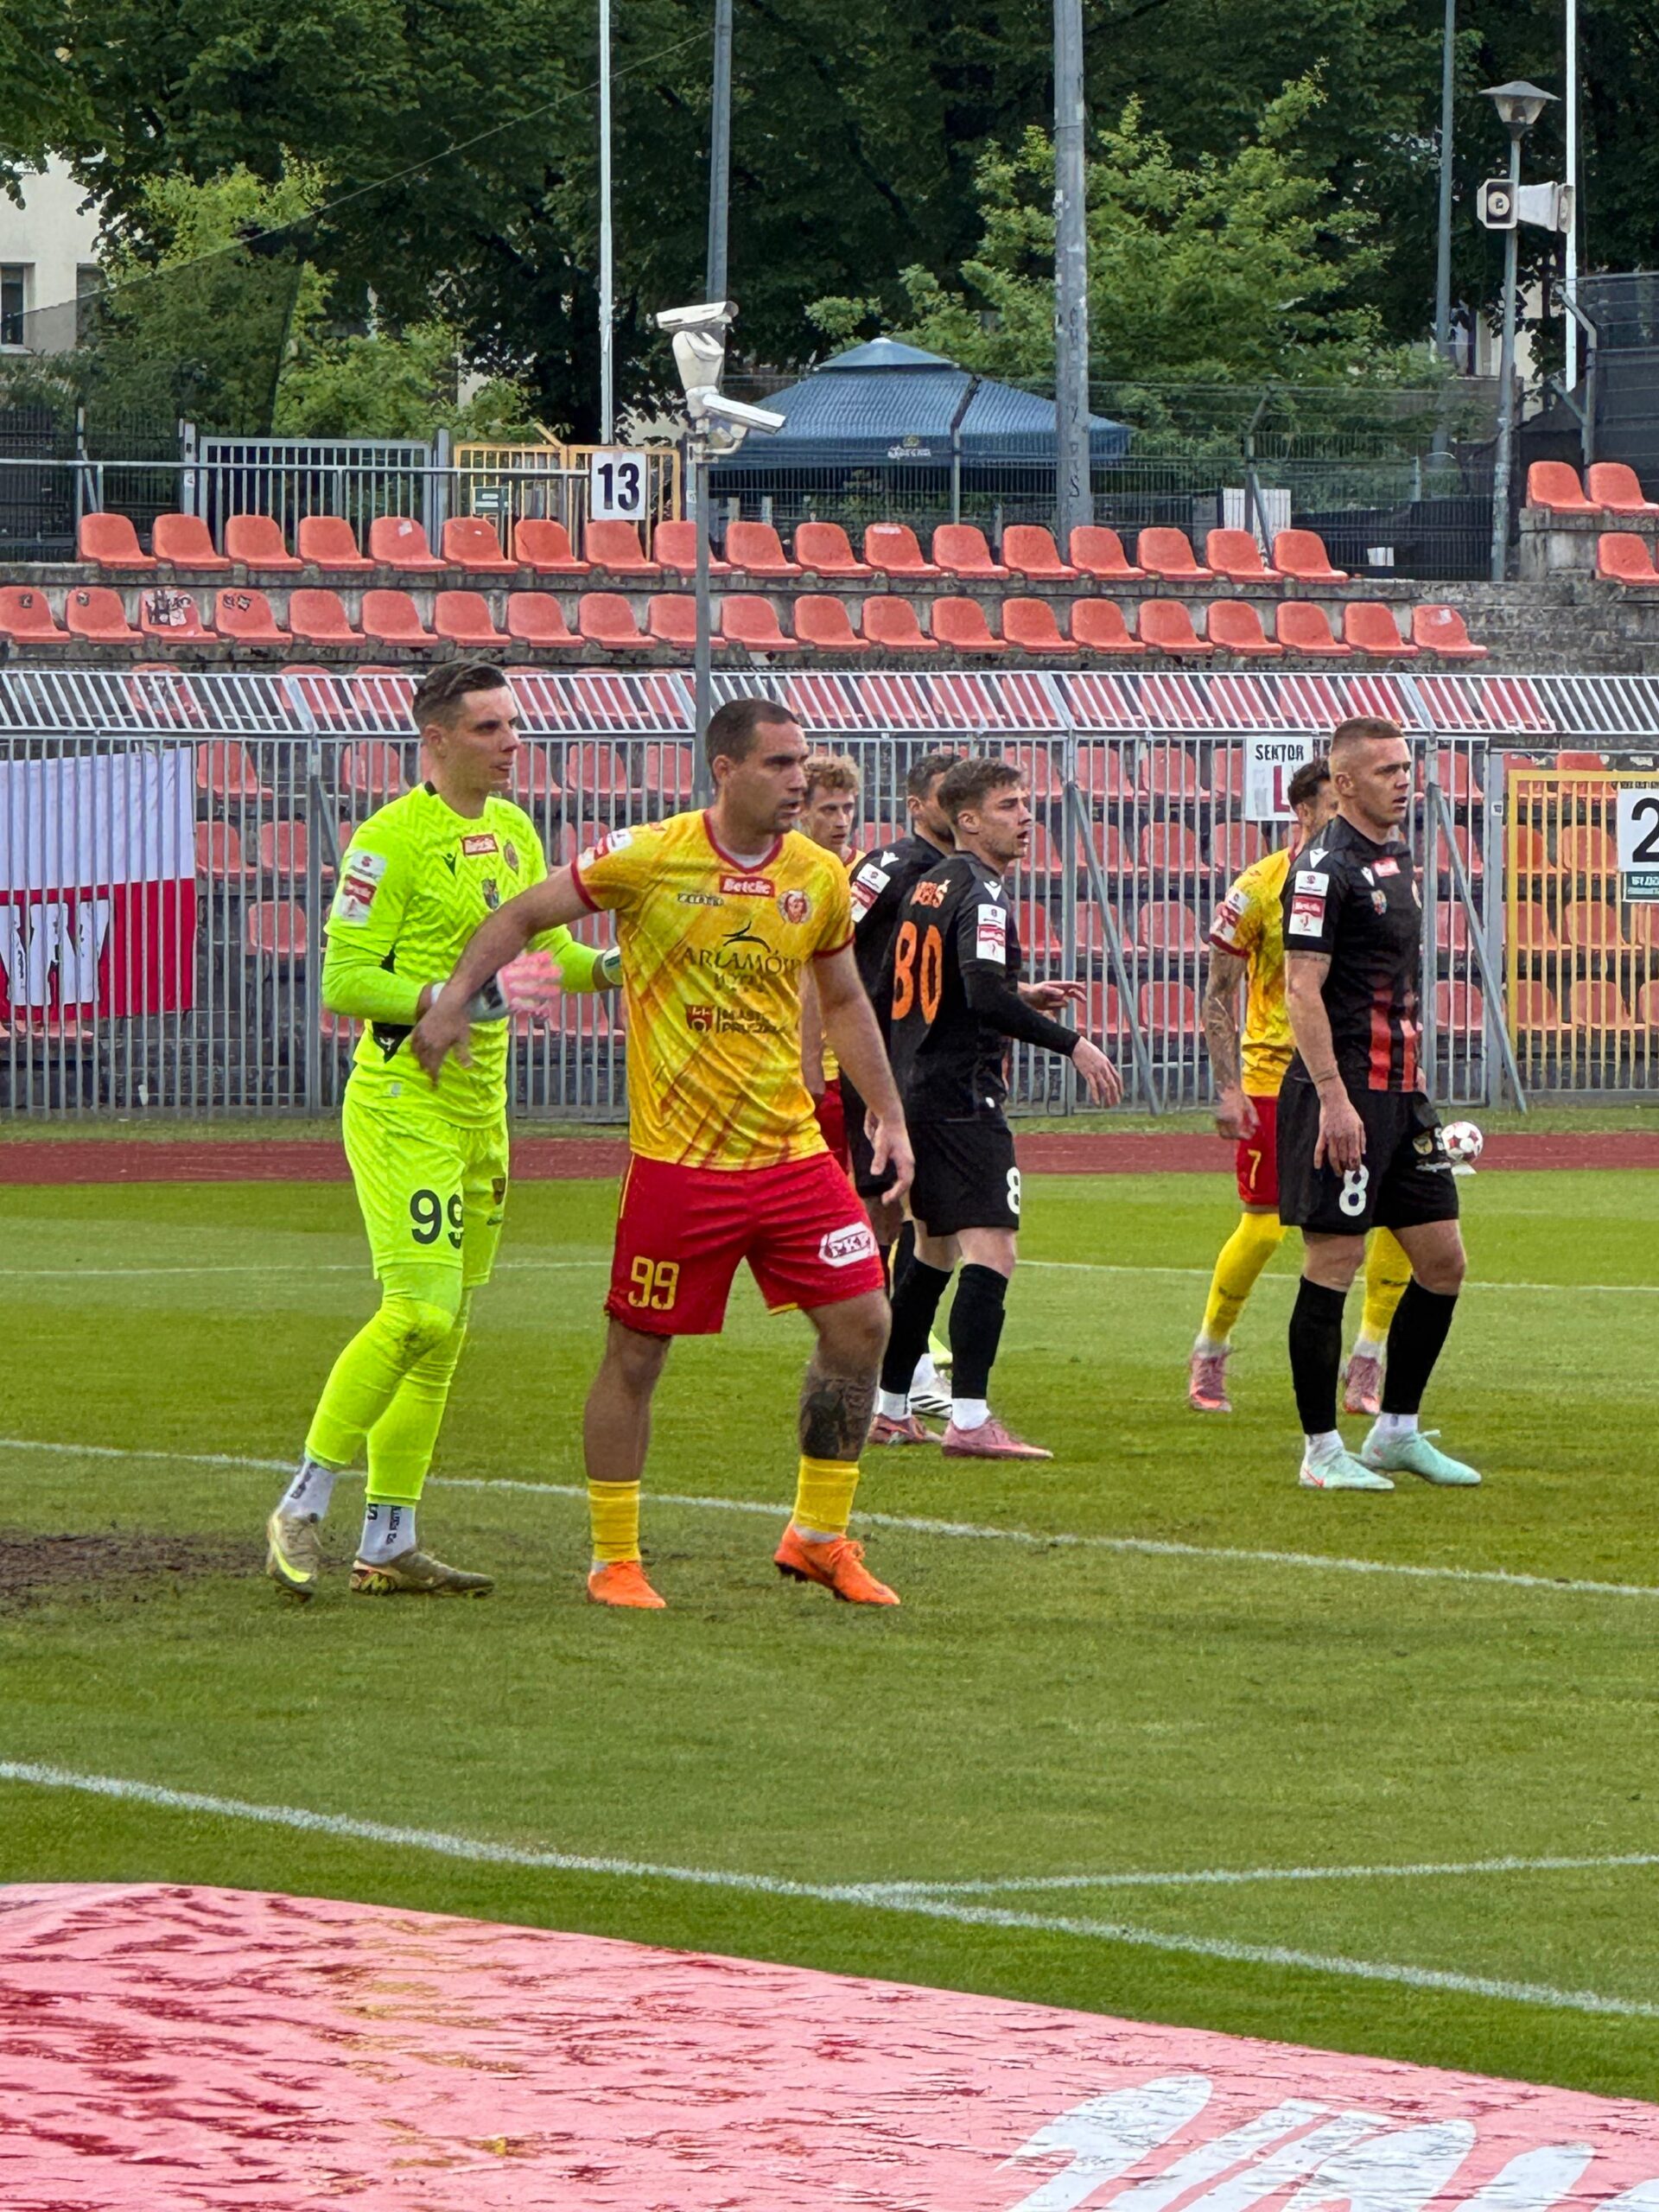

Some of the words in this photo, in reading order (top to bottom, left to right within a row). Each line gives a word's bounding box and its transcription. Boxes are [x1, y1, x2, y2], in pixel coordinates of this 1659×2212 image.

[598, 462, 639, 512] 13
[1255, 744, 1304, 762] SEKTOR
[891, 920, 943, 1026] 80
[1006, 1166, 1021, 1215] 8
[1247, 1148, 1262, 1190] 7
[1339, 1164, 1370, 1217] 8
[410, 1189, 464, 1249] 99
[628, 1255, 680, 1311] 99
